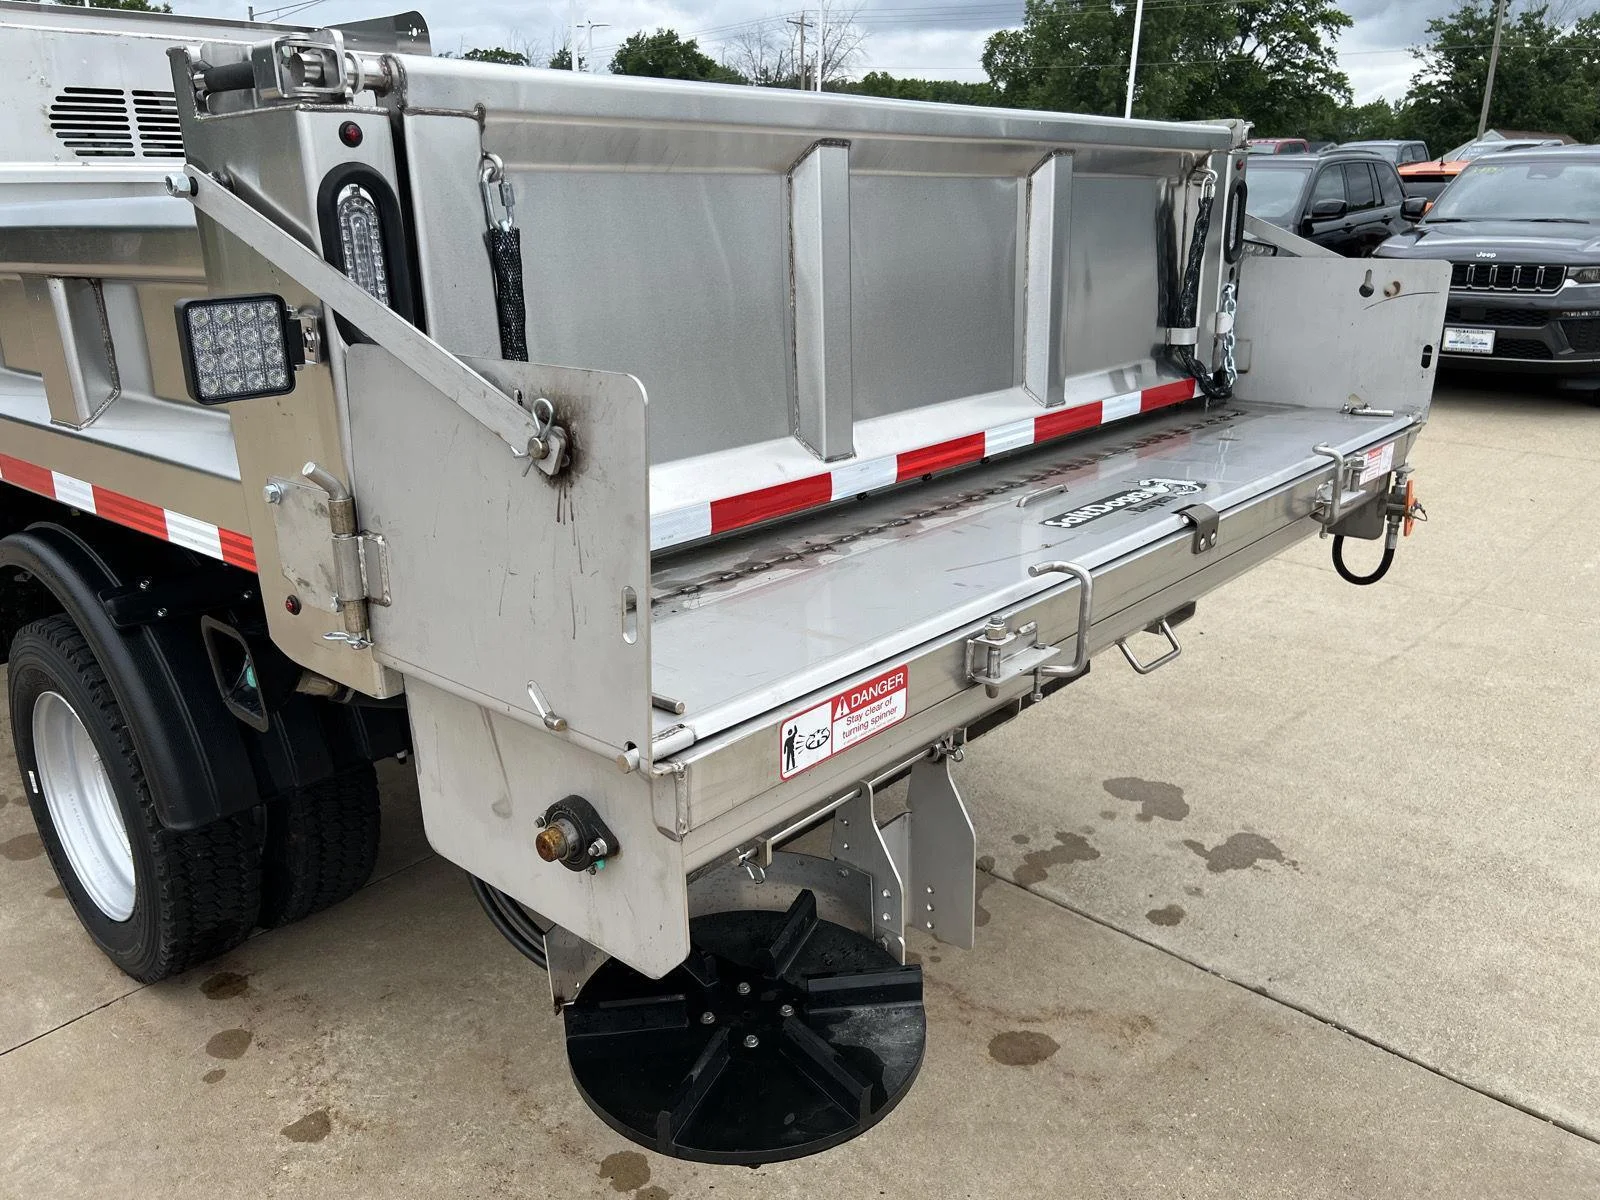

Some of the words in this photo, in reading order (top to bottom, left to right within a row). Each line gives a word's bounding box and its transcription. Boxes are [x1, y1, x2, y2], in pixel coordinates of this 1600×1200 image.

[851, 672, 904, 708] DANGER
[843, 721, 869, 739] turning
[870, 706, 898, 725] spinner
[846, 712, 863, 726] Stay
[865, 702, 883, 717] clear
[885, 696, 893, 707] of
